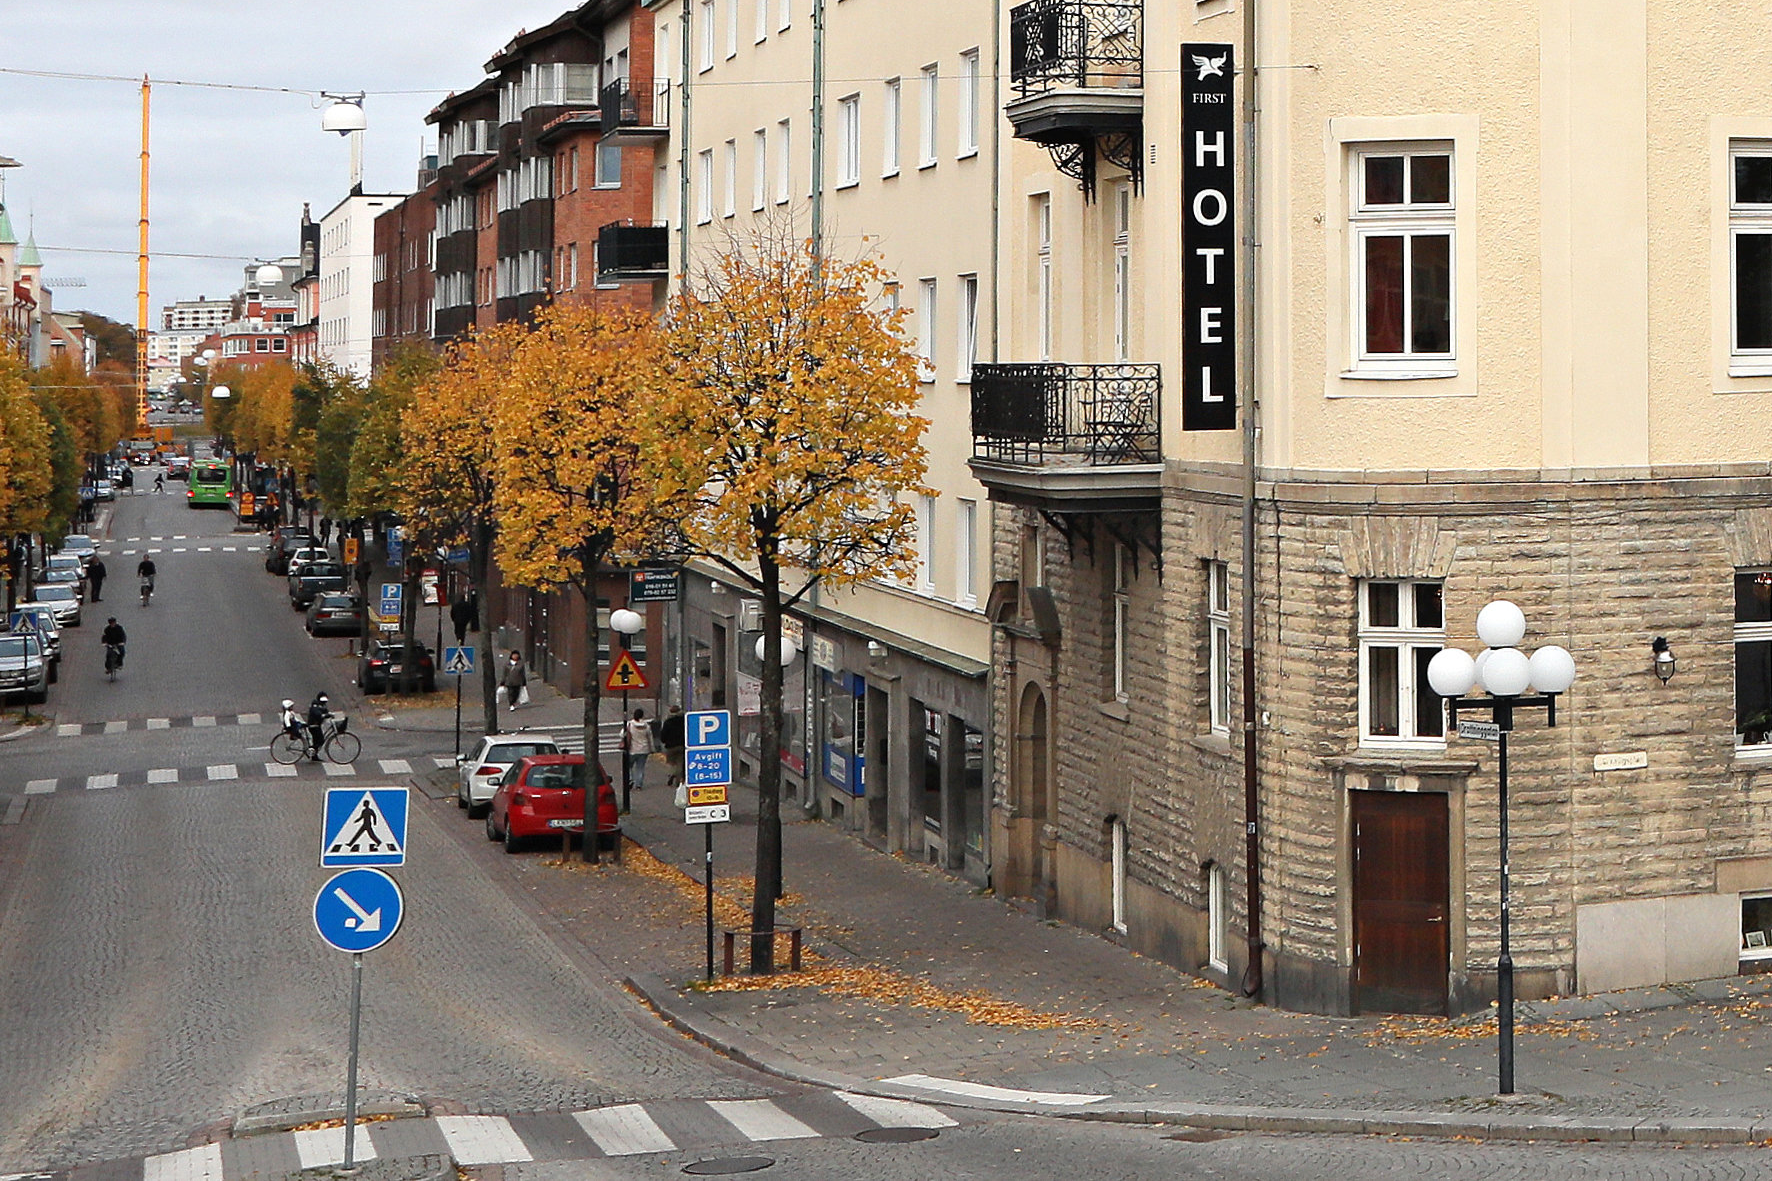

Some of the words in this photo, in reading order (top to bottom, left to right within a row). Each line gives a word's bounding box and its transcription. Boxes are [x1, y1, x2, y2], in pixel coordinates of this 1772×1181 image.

[1192, 93, 1227, 104] FIRST
[1192, 130, 1228, 403] HOTEL
[387, 585, 397, 598] P
[699, 716, 720, 745] P
[694, 752, 723, 762] Avgift
[710, 809, 717, 819] C
[720, 809, 727, 819] 3
